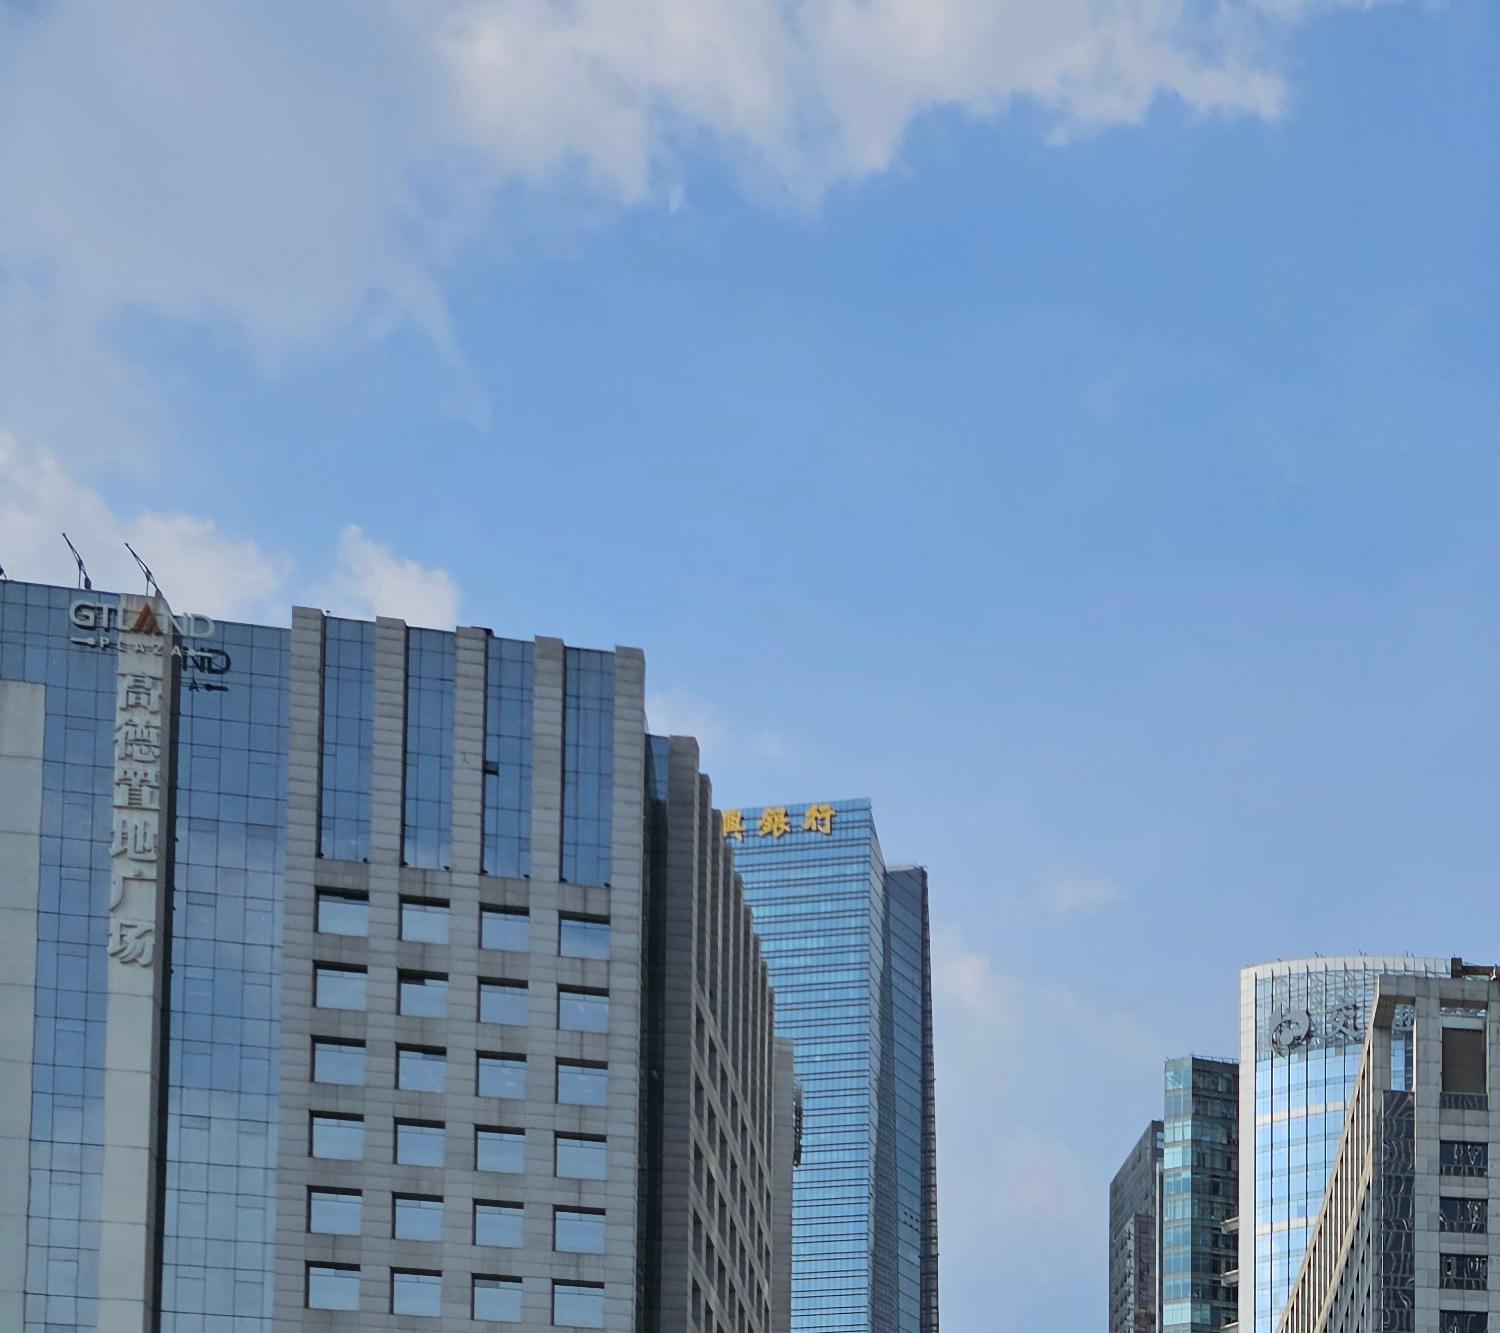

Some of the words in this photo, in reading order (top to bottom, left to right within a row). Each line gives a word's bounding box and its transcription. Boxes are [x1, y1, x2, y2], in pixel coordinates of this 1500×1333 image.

[100, 636, 183, 657] PLAZA
[106, 672, 162, 967] 高德置地广场
